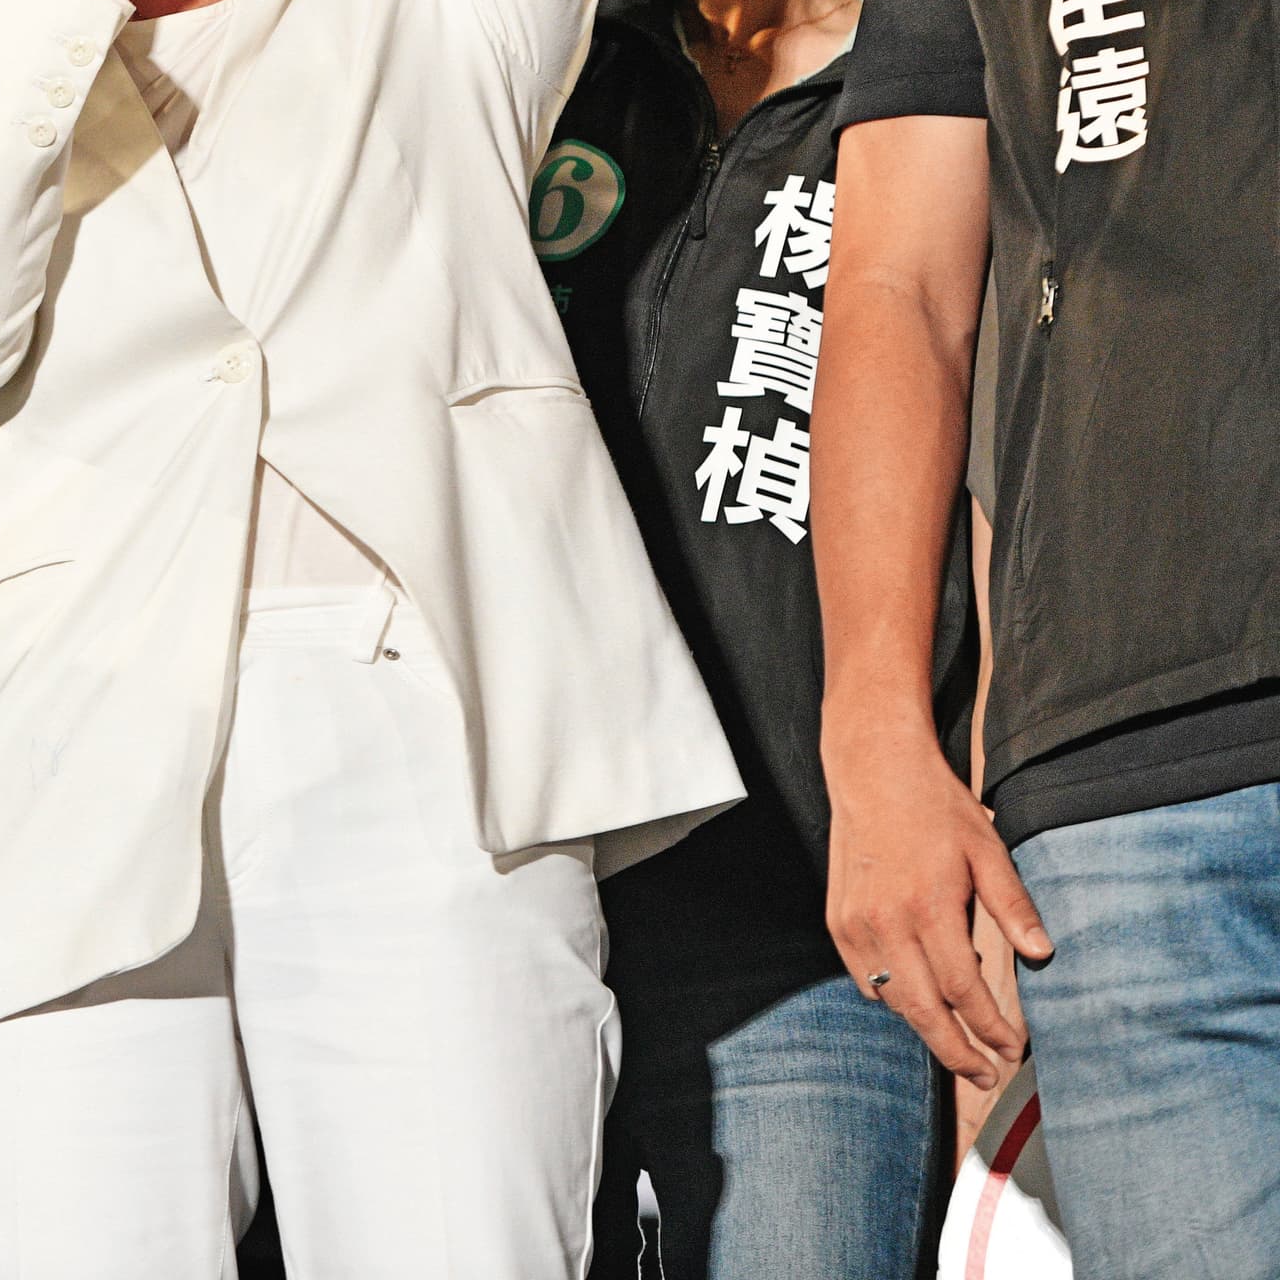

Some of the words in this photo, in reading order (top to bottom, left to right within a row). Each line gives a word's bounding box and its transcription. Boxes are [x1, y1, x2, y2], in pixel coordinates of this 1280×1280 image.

[528, 155, 594, 243] 6
[694, 174, 836, 546] 楊寶楨
